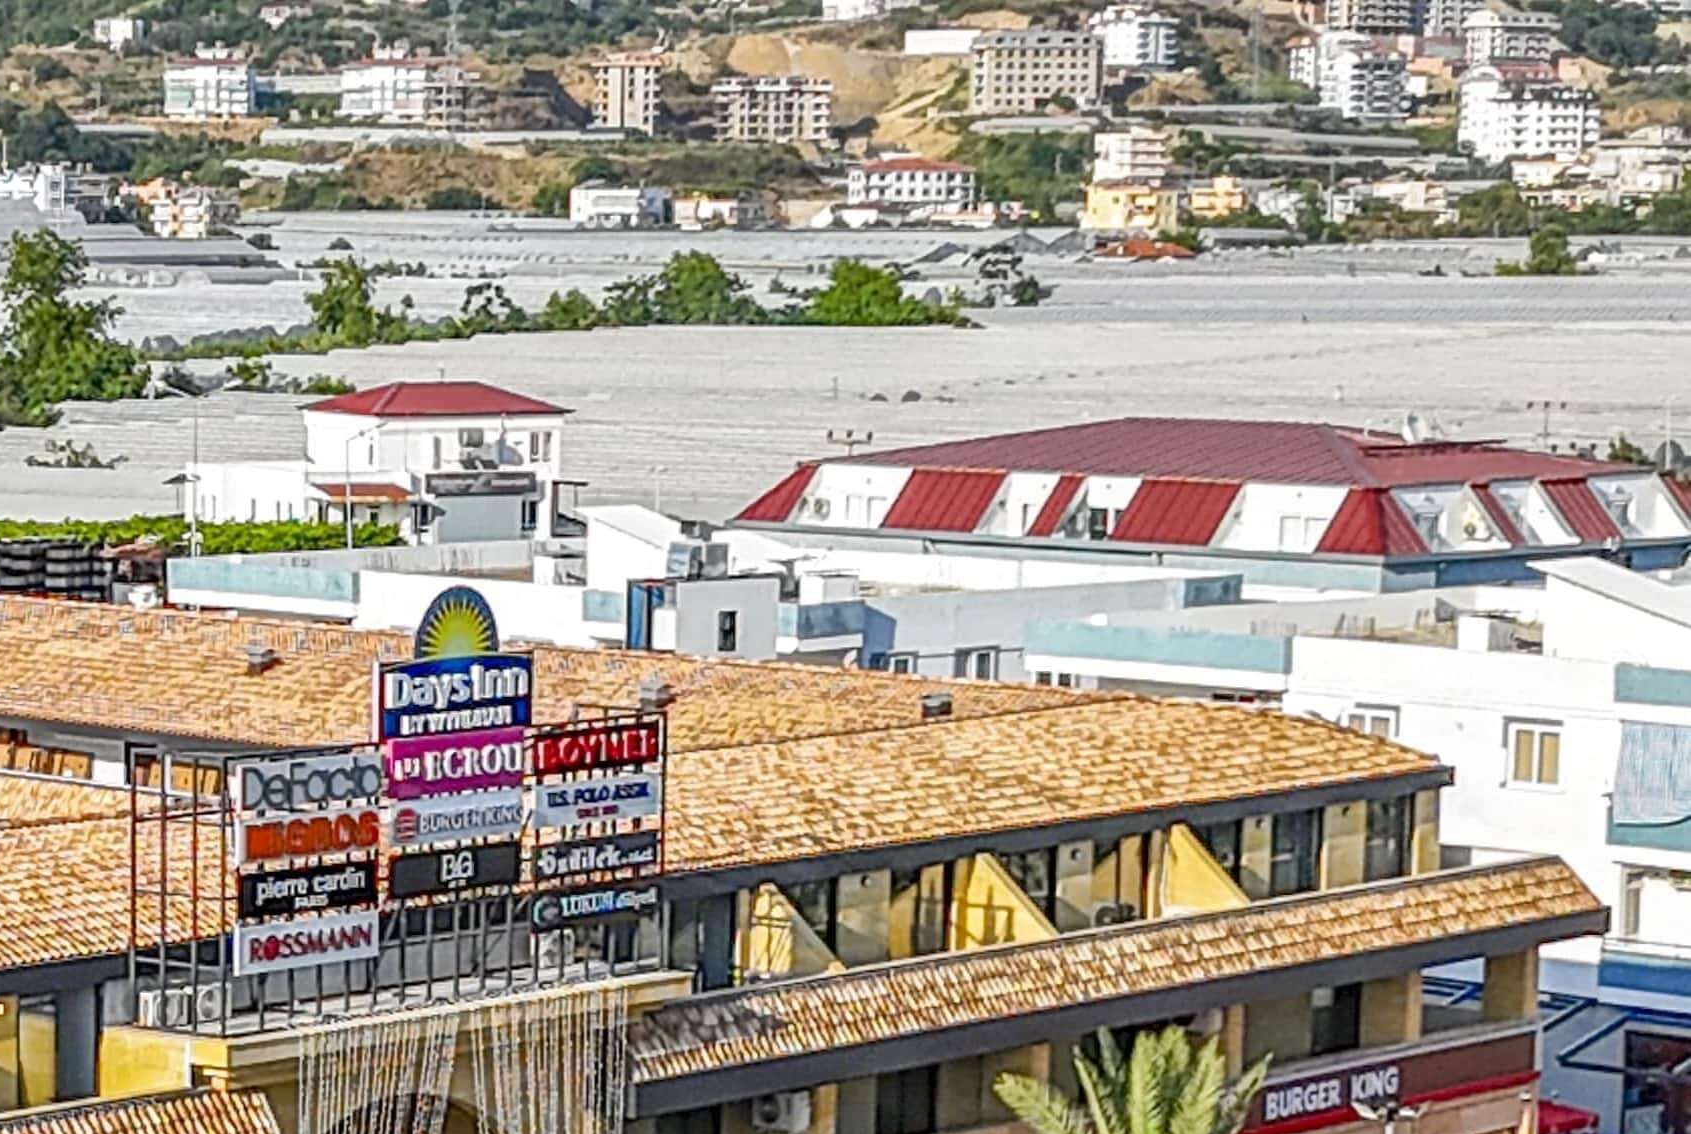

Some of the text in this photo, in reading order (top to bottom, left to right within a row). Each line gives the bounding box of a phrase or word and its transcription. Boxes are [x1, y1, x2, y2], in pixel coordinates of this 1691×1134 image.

[384, 663, 529, 709] Days Inn
[242, 757, 382, 812] DeFacto
[249, 922, 374, 964] ROSSMANN
[1265, 1066, 1401, 1121] BURGER KING
